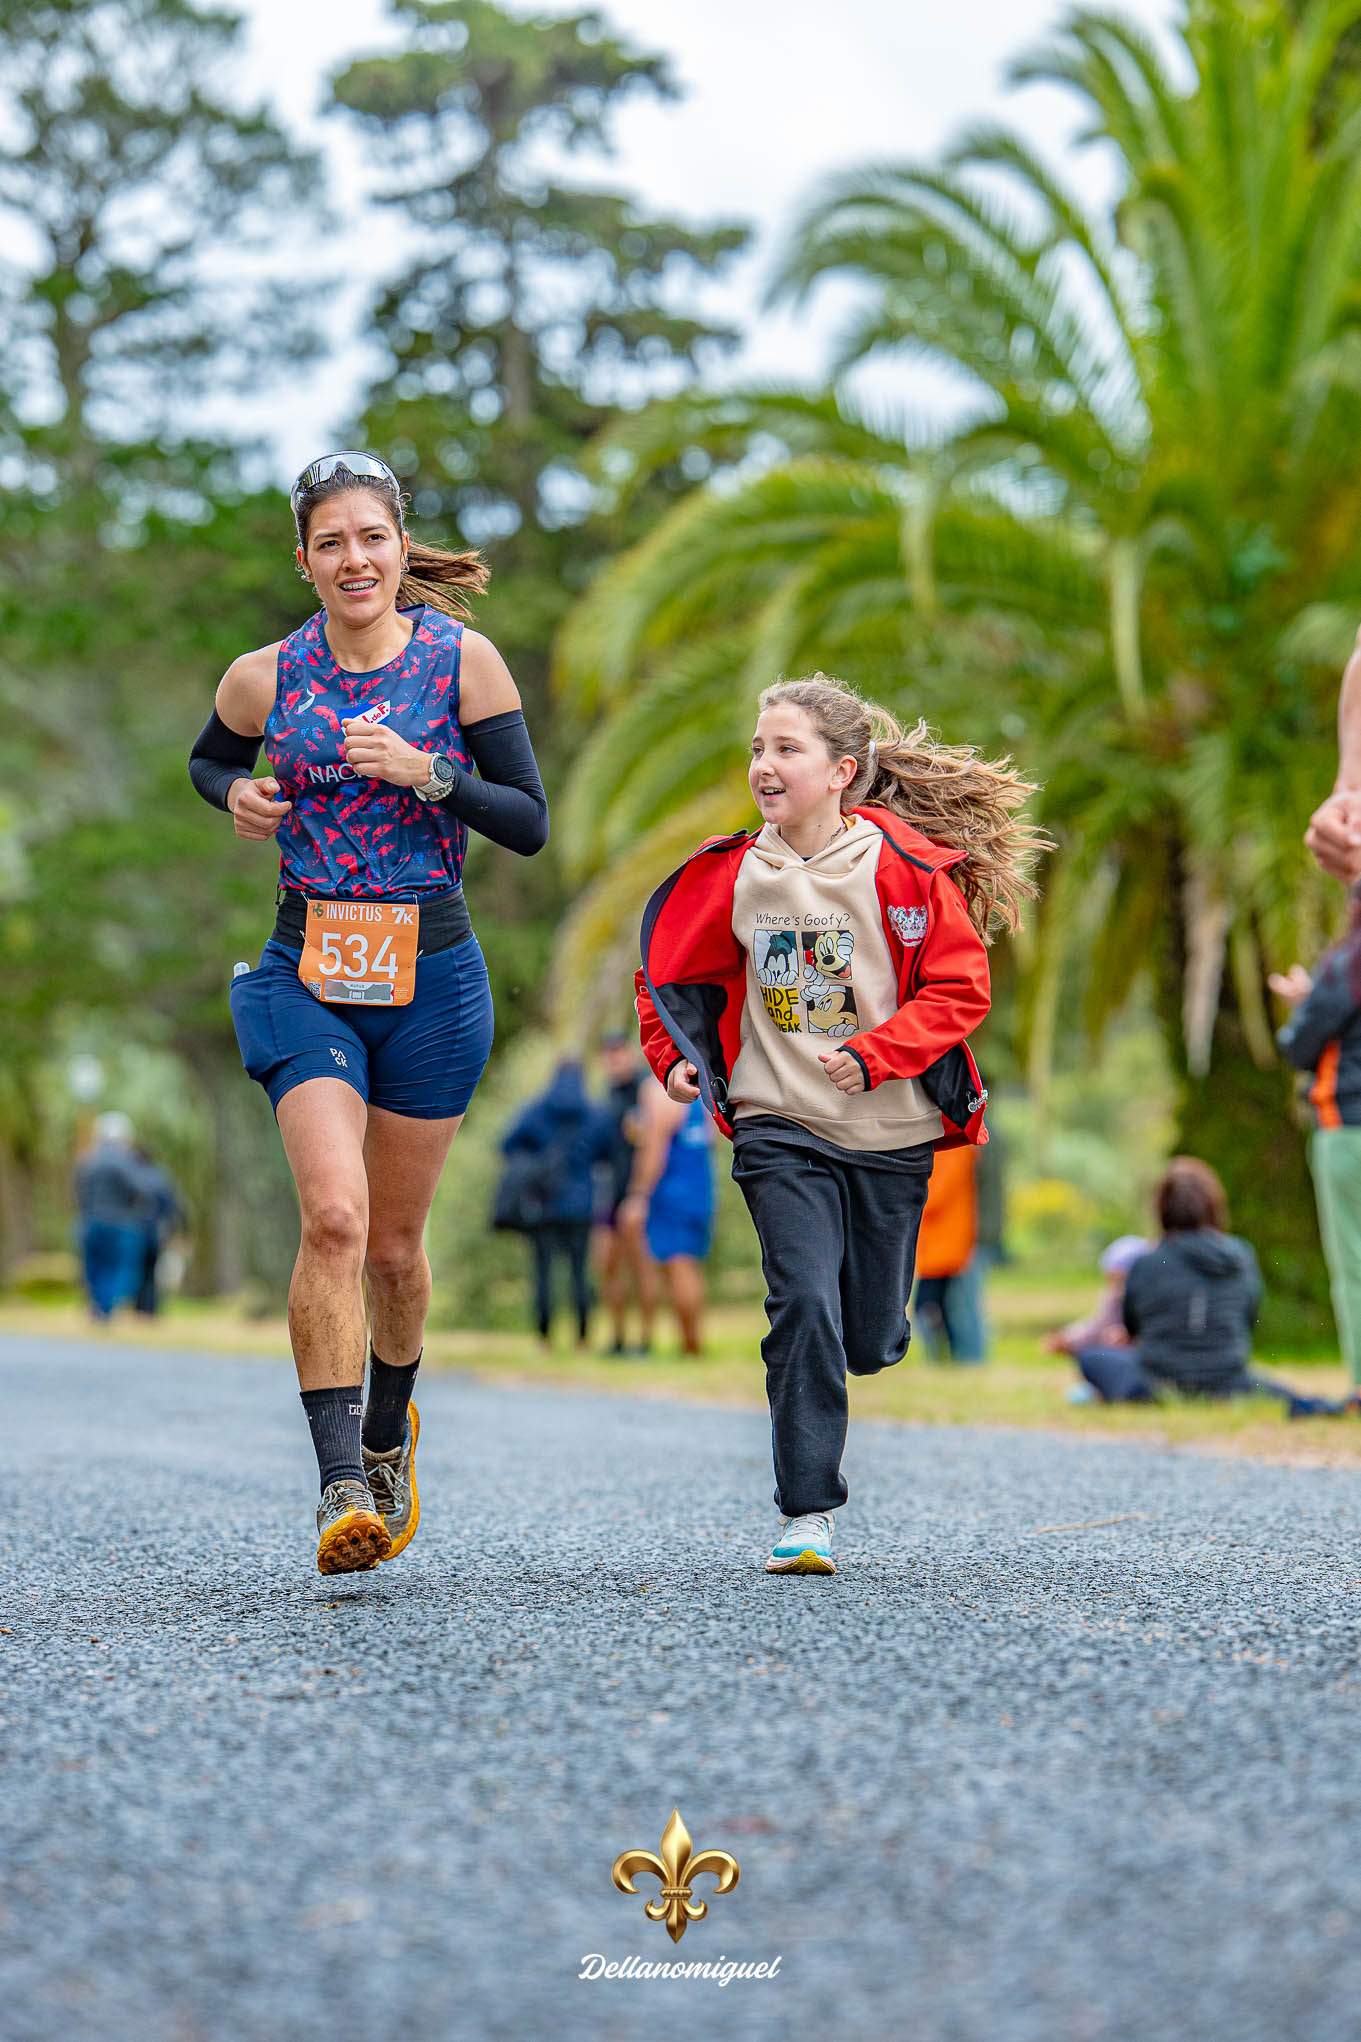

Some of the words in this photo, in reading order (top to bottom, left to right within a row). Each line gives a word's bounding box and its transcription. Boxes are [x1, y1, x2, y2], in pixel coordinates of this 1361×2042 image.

[308, 763, 377, 784] NAC
[326, 903, 383, 922] INVICTUS
[756, 912, 800, 926] Where's
[804, 912, 851, 928] Goofy?
[318, 932, 399, 979] 534
[760, 986, 799, 1006] HIDE
[767, 1006, 793, 1021] and
